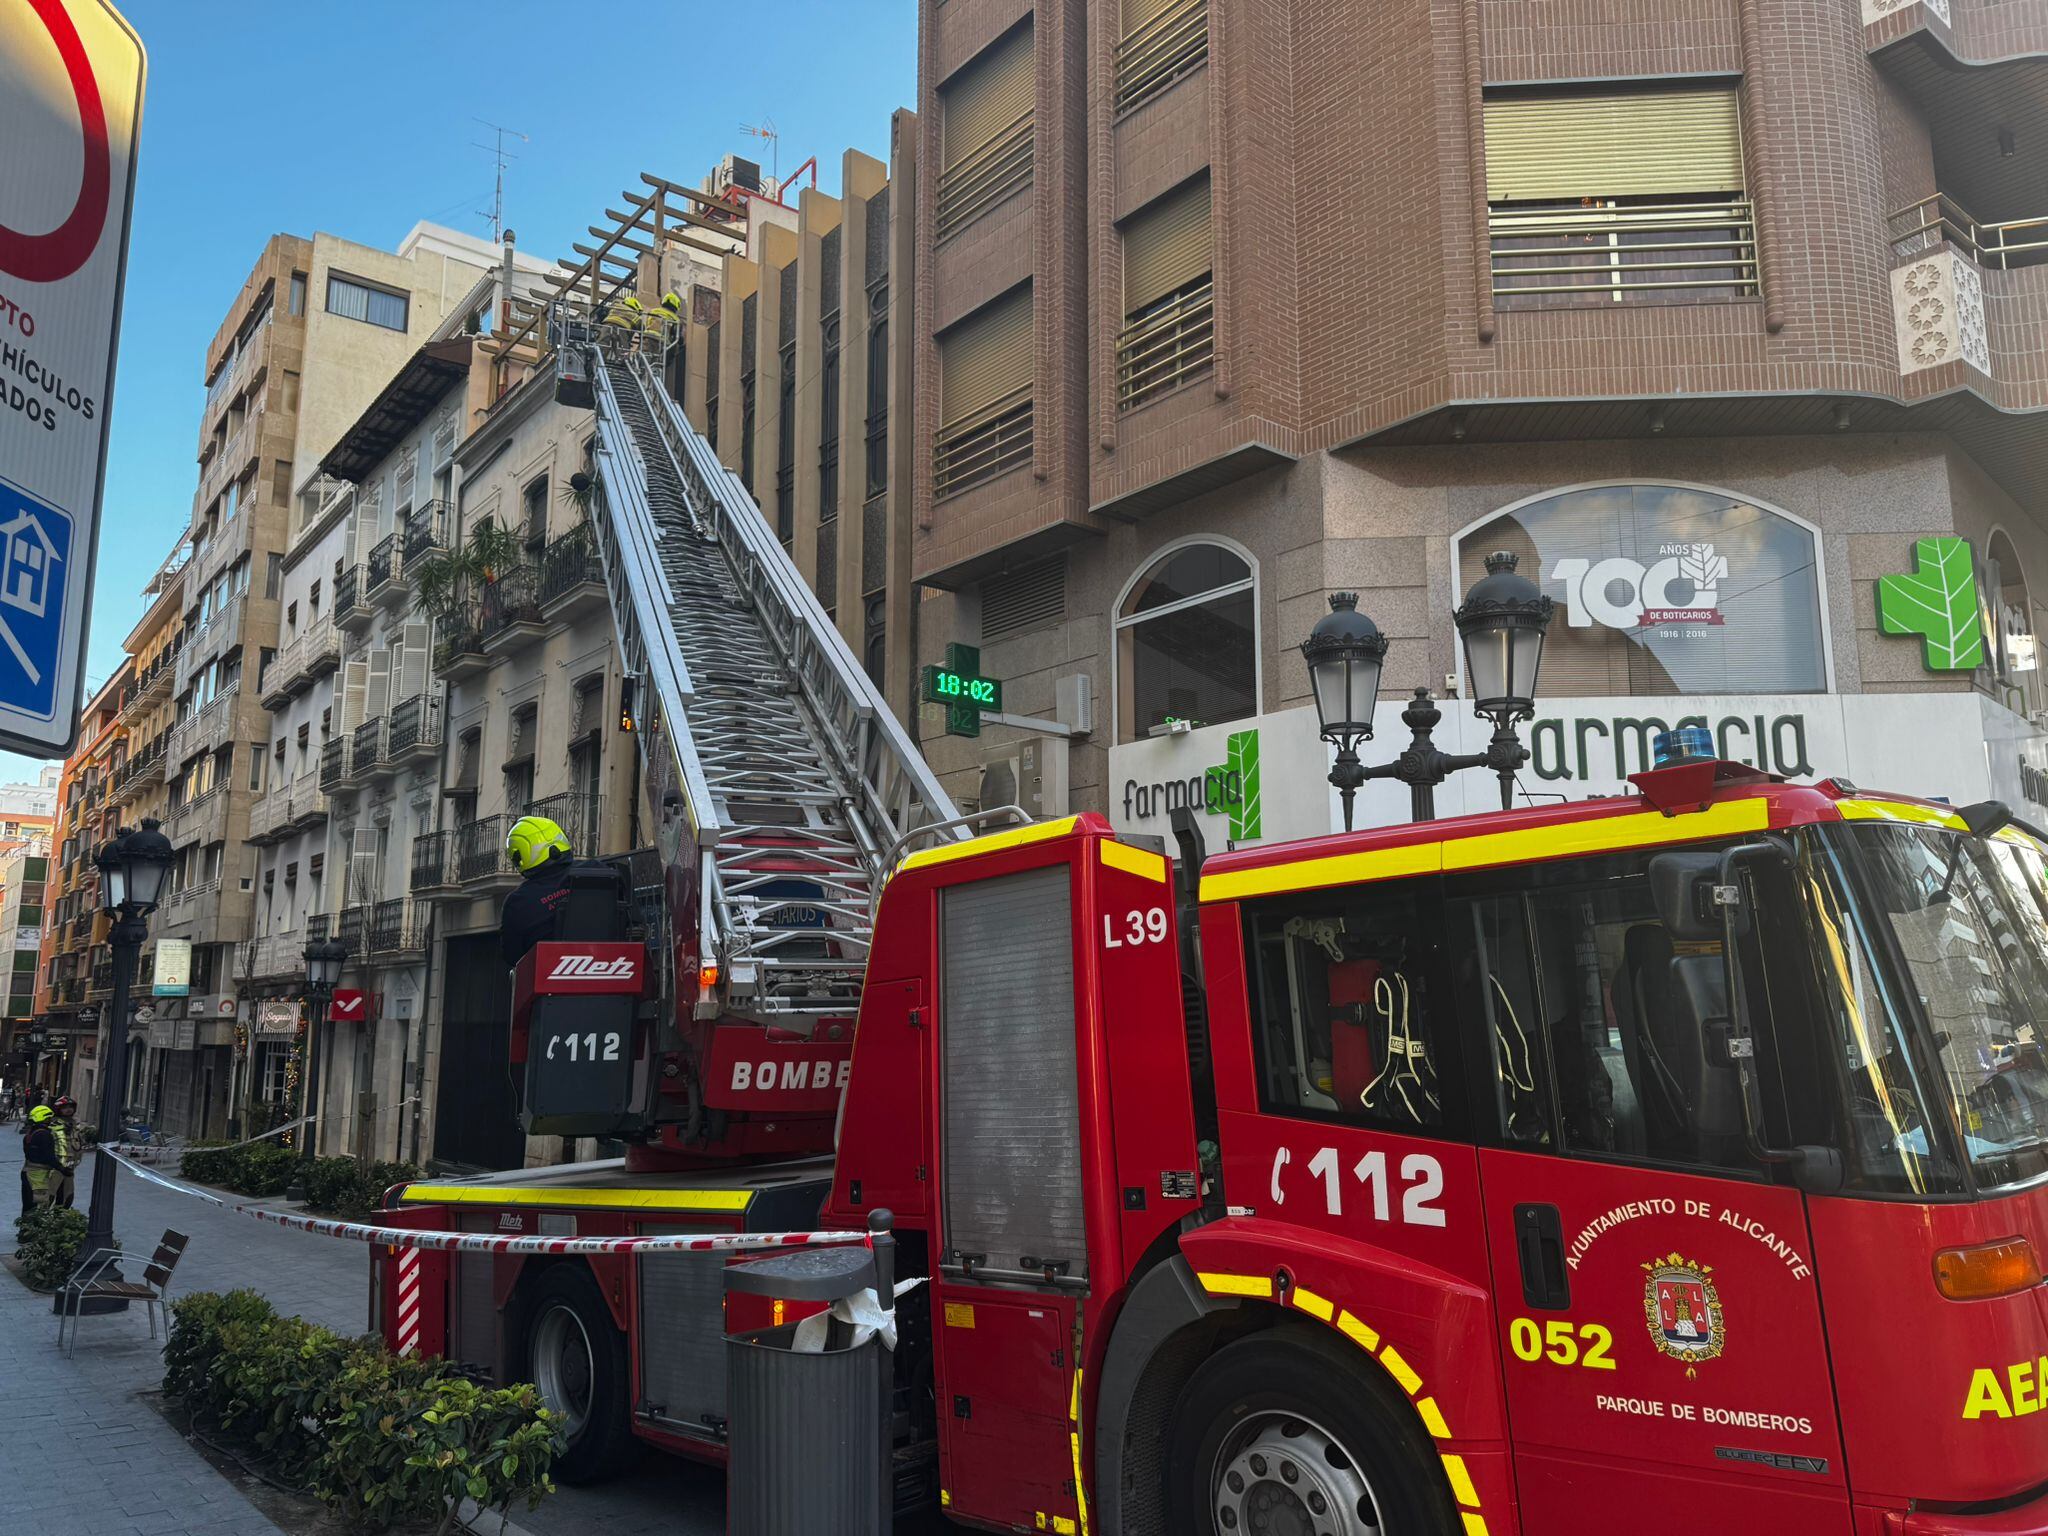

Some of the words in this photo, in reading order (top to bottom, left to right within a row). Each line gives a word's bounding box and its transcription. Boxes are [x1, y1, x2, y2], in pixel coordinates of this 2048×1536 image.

[0, 340, 94, 420] HÍCULOS
[1659, 542, 1690, 555] AÑOS
[1551, 557, 1722, 629] 100
[1650, 611, 1661, 620] DE
[1662, 611, 1712, 620] BOTICARIOS
[1659, 630, 1679, 639] 1916
[1686, 630, 1707, 639] 2016
[937, 672, 994, 703] 18:02
[1524, 713, 1815, 782] armcia
[1123, 769, 1243, 821] farmacia
[540, 888, 572, 904] BOMB
[1103, 907, 1167, 949] L39
[547, 955, 635, 980] Metz
[565, 1032, 621, 1062] 112
[731, 1060, 851, 1090] BOMBE
[1307, 1147, 1446, 1228] 112
[498, 1213, 523, 1230] Metz
[1684, 1199, 1711, 1218] DE
[1718, 1209, 1812, 1281] ALICANTE
[1661, 1289, 1671, 1300] A
[1693, 1291, 1701, 1302] L
[1664, 1310, 1672, 1321] L
[1695, 1312, 1705, 1323] A
[1509, 1317, 1617, 1370] 052
[1596, 1395, 1665, 1417] PARQUE
[1671, 1403, 1697, 1421] DE
[1702, 1406, 1813, 1435] BOMBEROS
